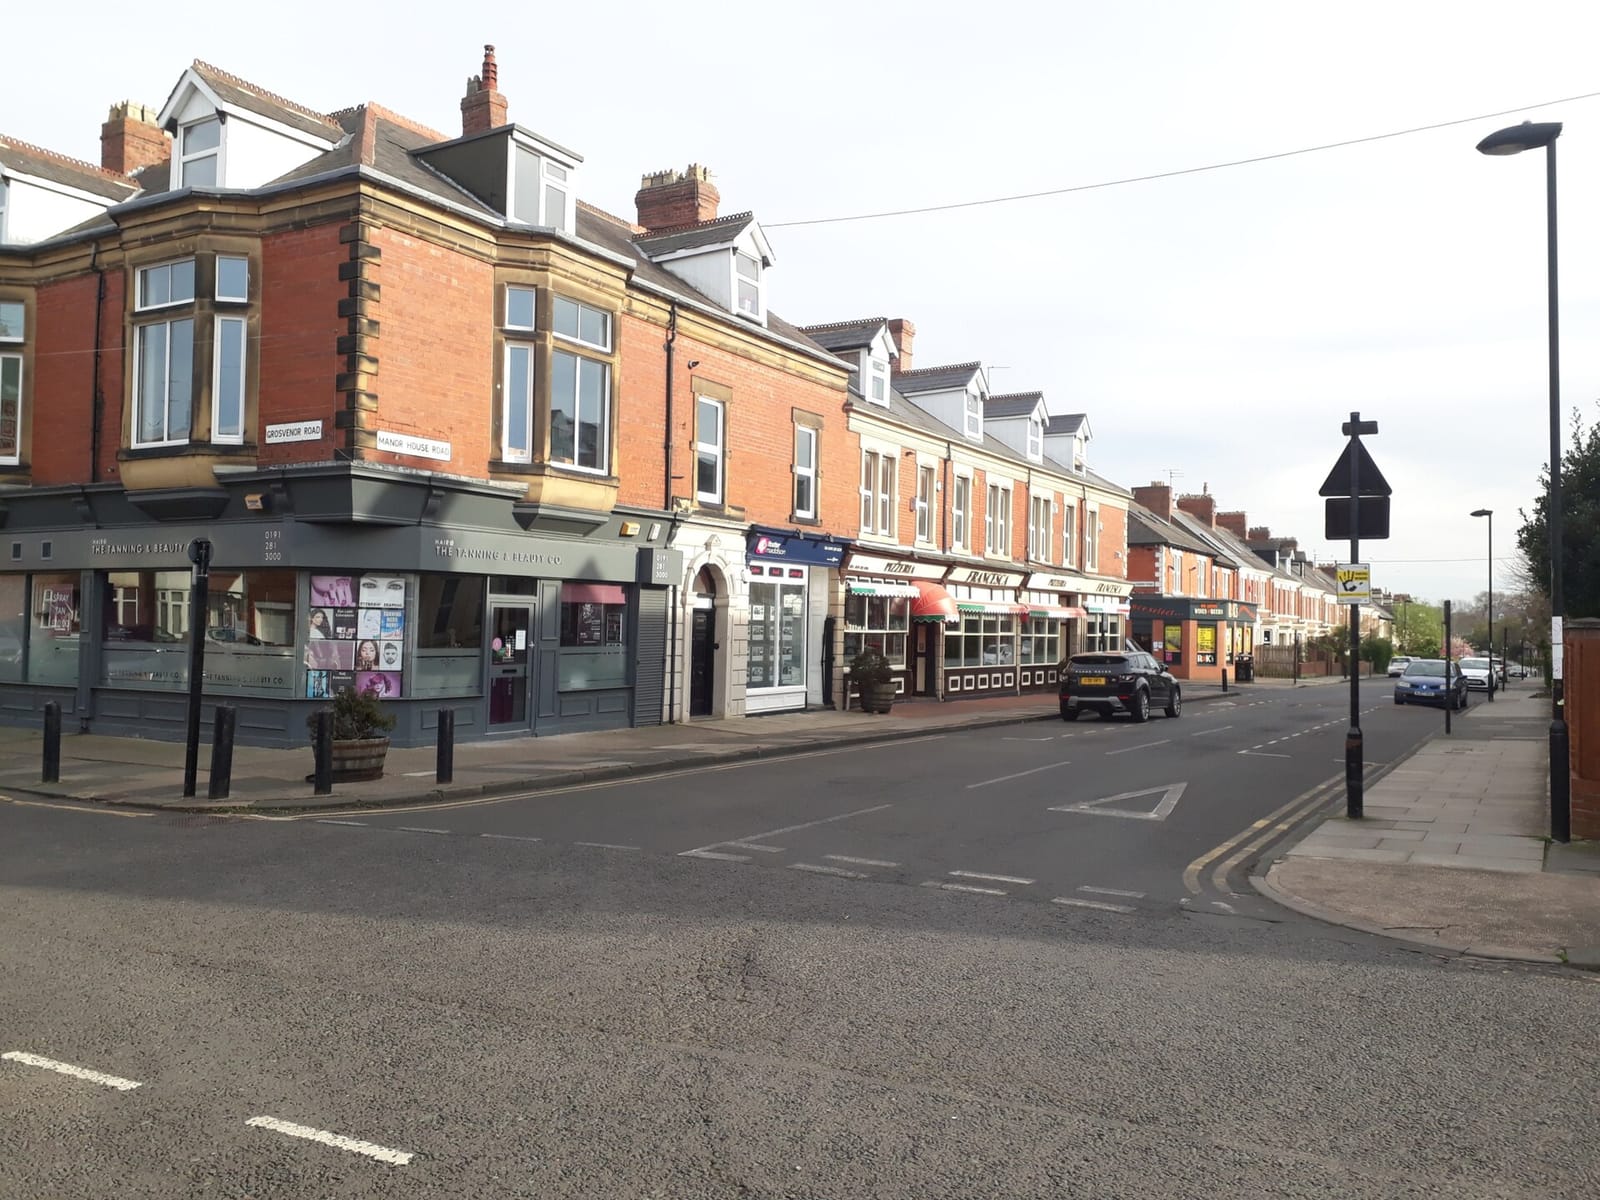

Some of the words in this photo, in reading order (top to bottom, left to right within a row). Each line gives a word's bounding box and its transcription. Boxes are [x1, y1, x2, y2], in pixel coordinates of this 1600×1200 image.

[267, 426, 302, 439] GROSVENOR
[303, 425, 321, 436] ROAD
[378, 436, 403, 448] MANOR
[406, 441, 429, 453] HOUSE
[431, 446, 450, 456] ROAD
[265, 530, 281, 540] 0191
[92, 545, 106, 555] THE
[107, 544, 143, 555] TANNING
[154, 543, 184, 553] BEAUTY
[265, 541, 277, 551] 281
[265, 552, 281, 561] 3000
[435, 546, 453, 557] THE
[455, 548, 499, 560] TANNING
[512, 552, 544, 563] BEAUTY
[884, 563, 916, 574] PIZZERIA
[966, 571, 1010, 587] FRANCESCA
[53, 593, 69, 601] SPRAY
